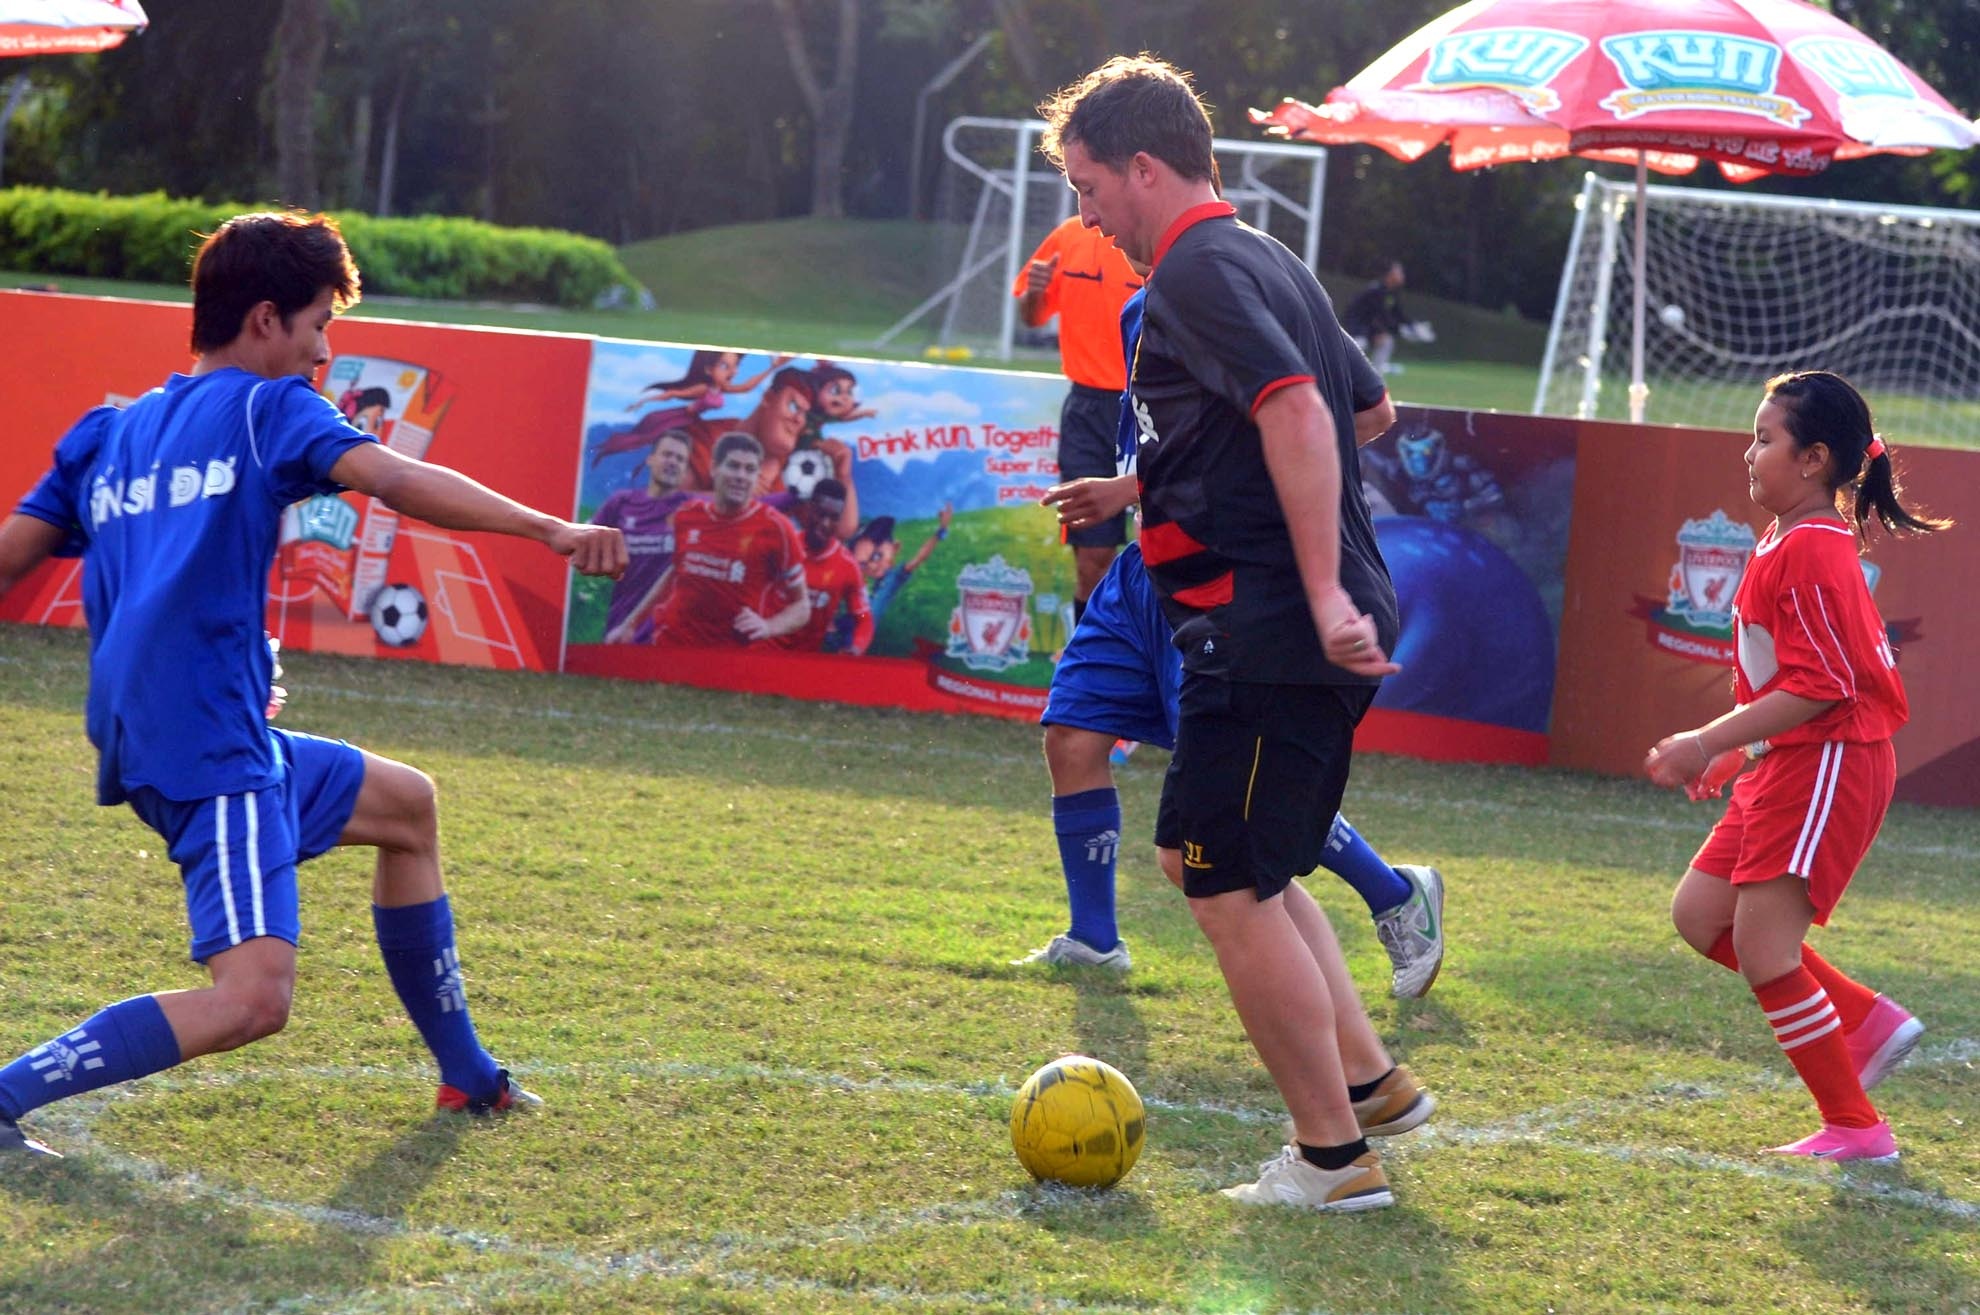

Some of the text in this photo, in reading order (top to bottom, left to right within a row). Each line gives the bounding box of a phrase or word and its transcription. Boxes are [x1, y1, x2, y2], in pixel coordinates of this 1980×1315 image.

[858, 429, 921, 459] Drink
[986, 456, 1033, 477] Super
[1657, 632, 1722, 659] REGIONAL
